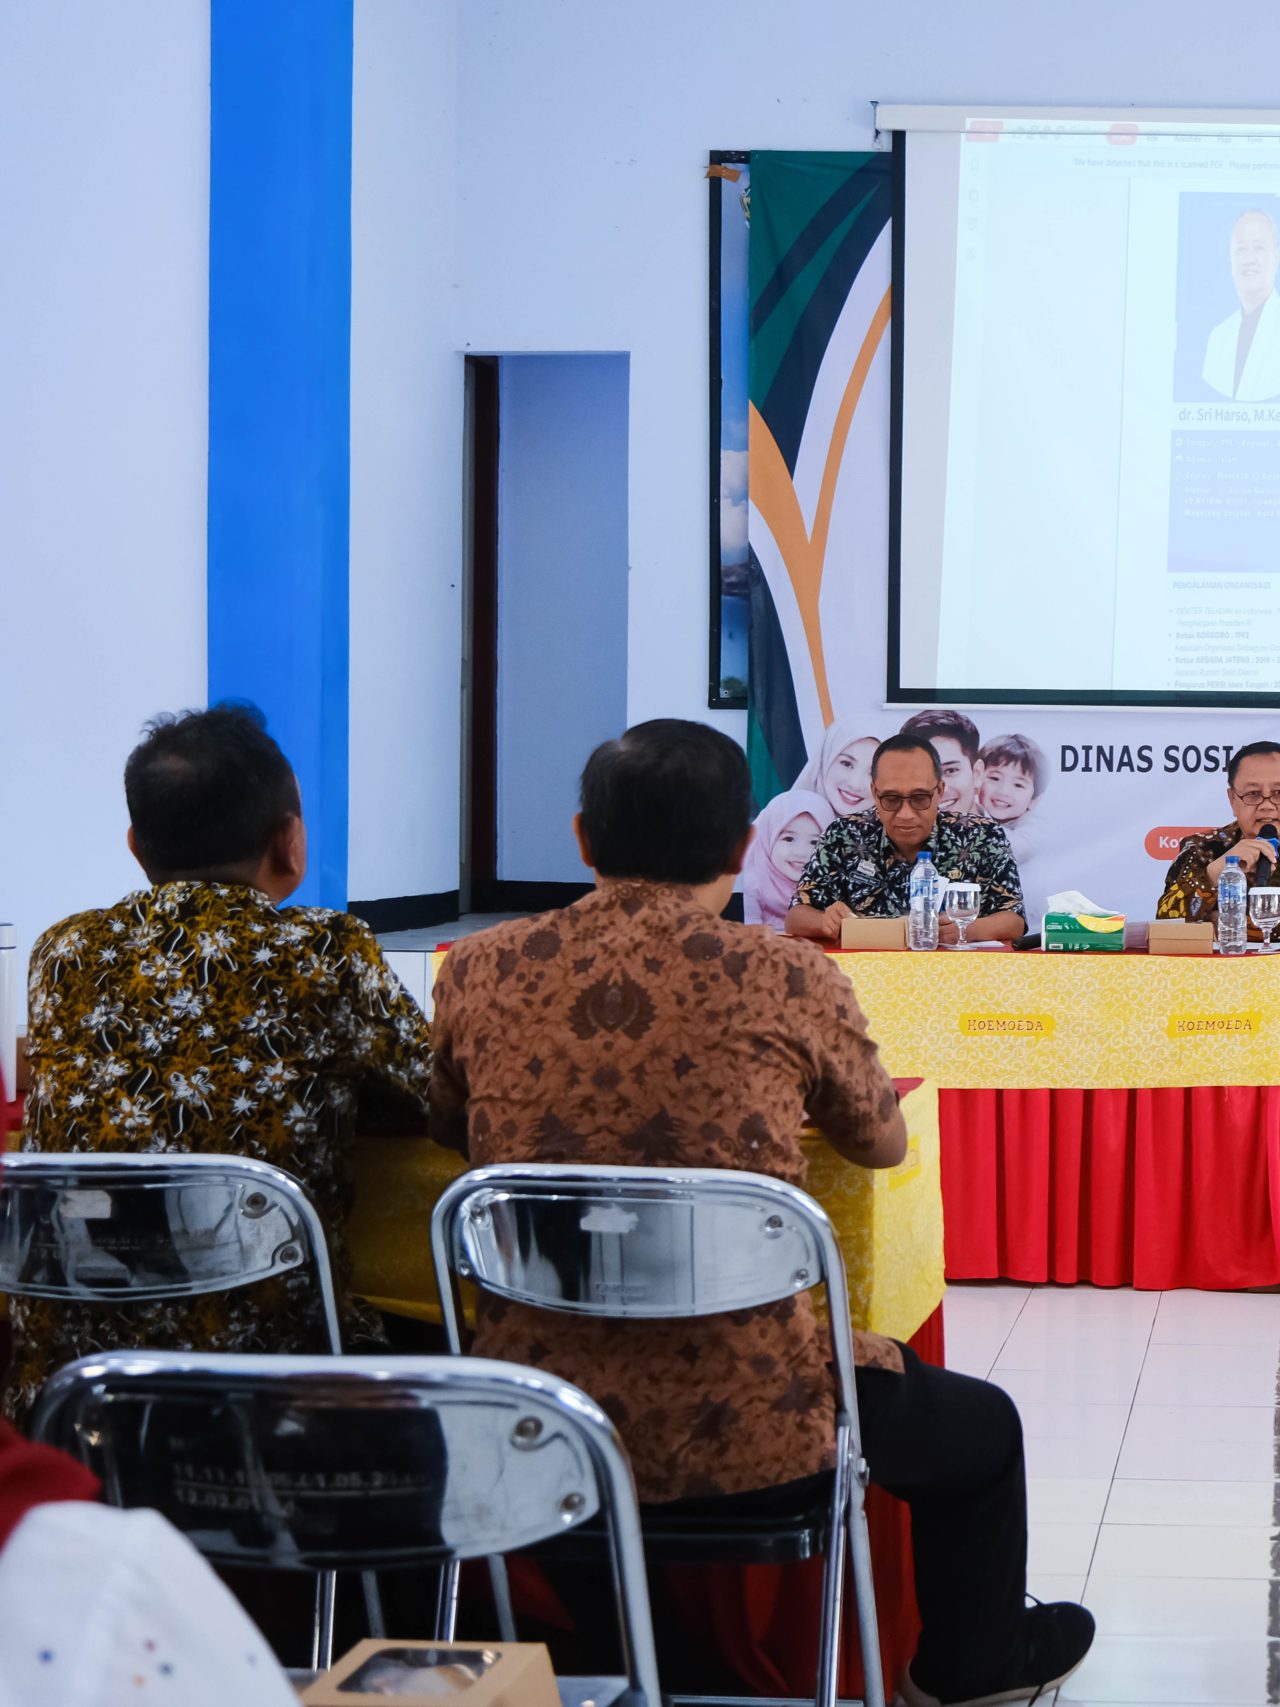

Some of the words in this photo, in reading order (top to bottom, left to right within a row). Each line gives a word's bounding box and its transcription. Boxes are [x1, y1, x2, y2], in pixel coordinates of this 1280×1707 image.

[1178, 408, 1194, 421] dr.
[1197, 408, 1212, 421] Sri
[1215, 408, 1251, 424] Harso,
[1061, 745, 1153, 773] DINAS
[1163, 745, 1232, 773] SOSI
[967, 1018, 1044, 1033] KOEMOEDA
[1176, 1018, 1252, 1034] KOEMOEDA
